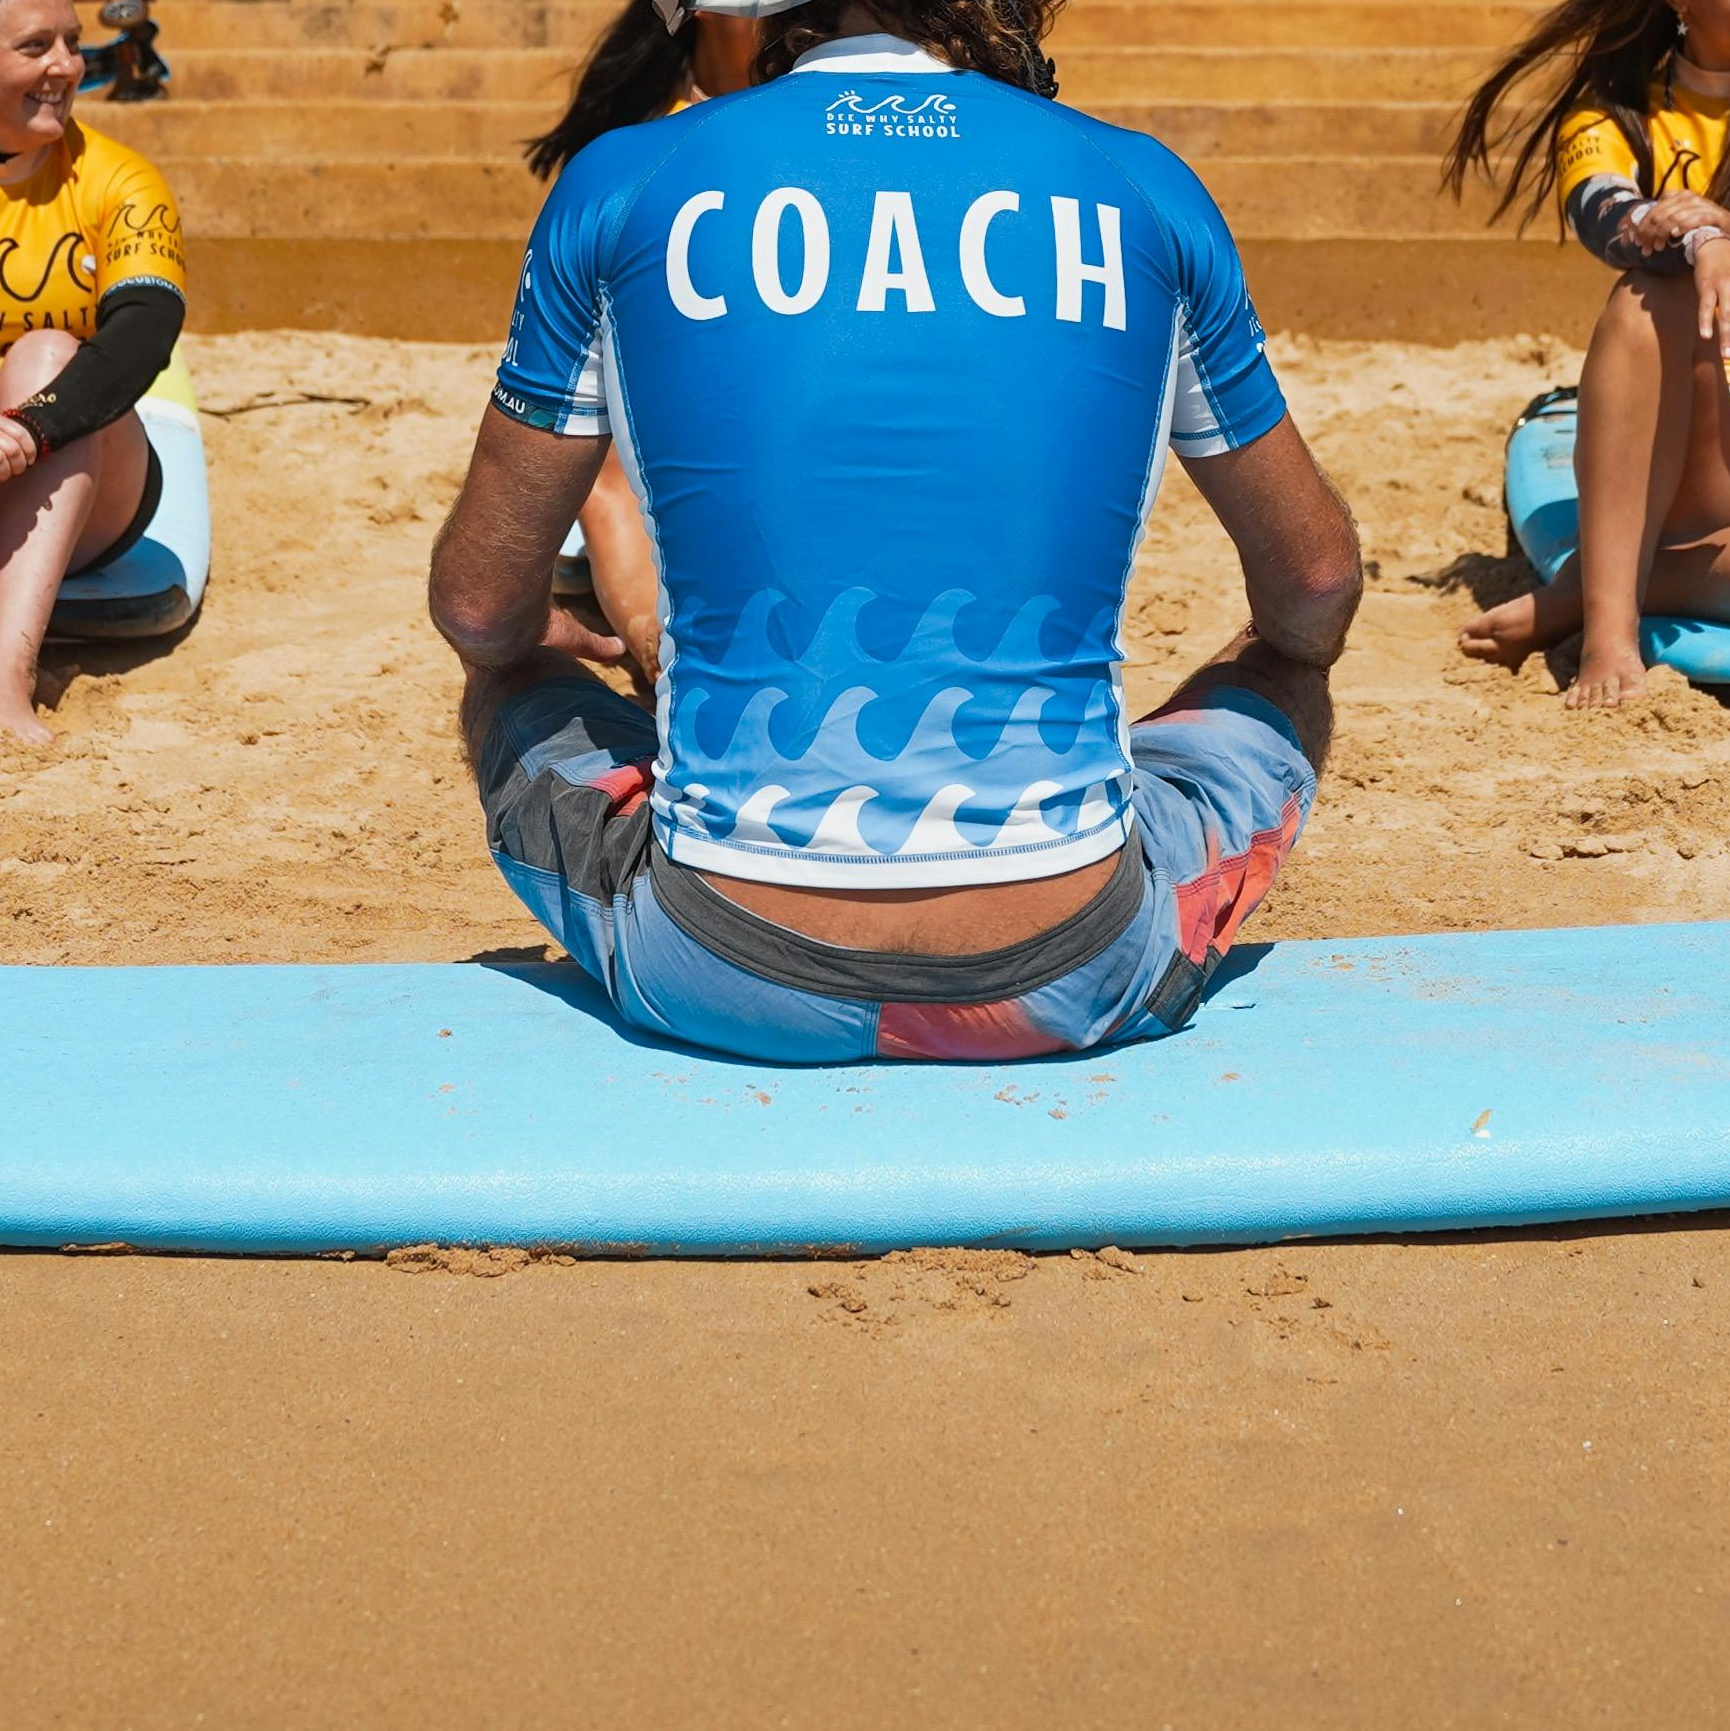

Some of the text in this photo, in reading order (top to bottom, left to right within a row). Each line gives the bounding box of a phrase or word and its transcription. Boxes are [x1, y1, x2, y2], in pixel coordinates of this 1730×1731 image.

[865, 114, 899, 124] WHY
[907, 115, 957, 124] SALTY
[826, 123, 961, 138] SURF SCHOOL
[665, 186, 1127, 332] COACH
